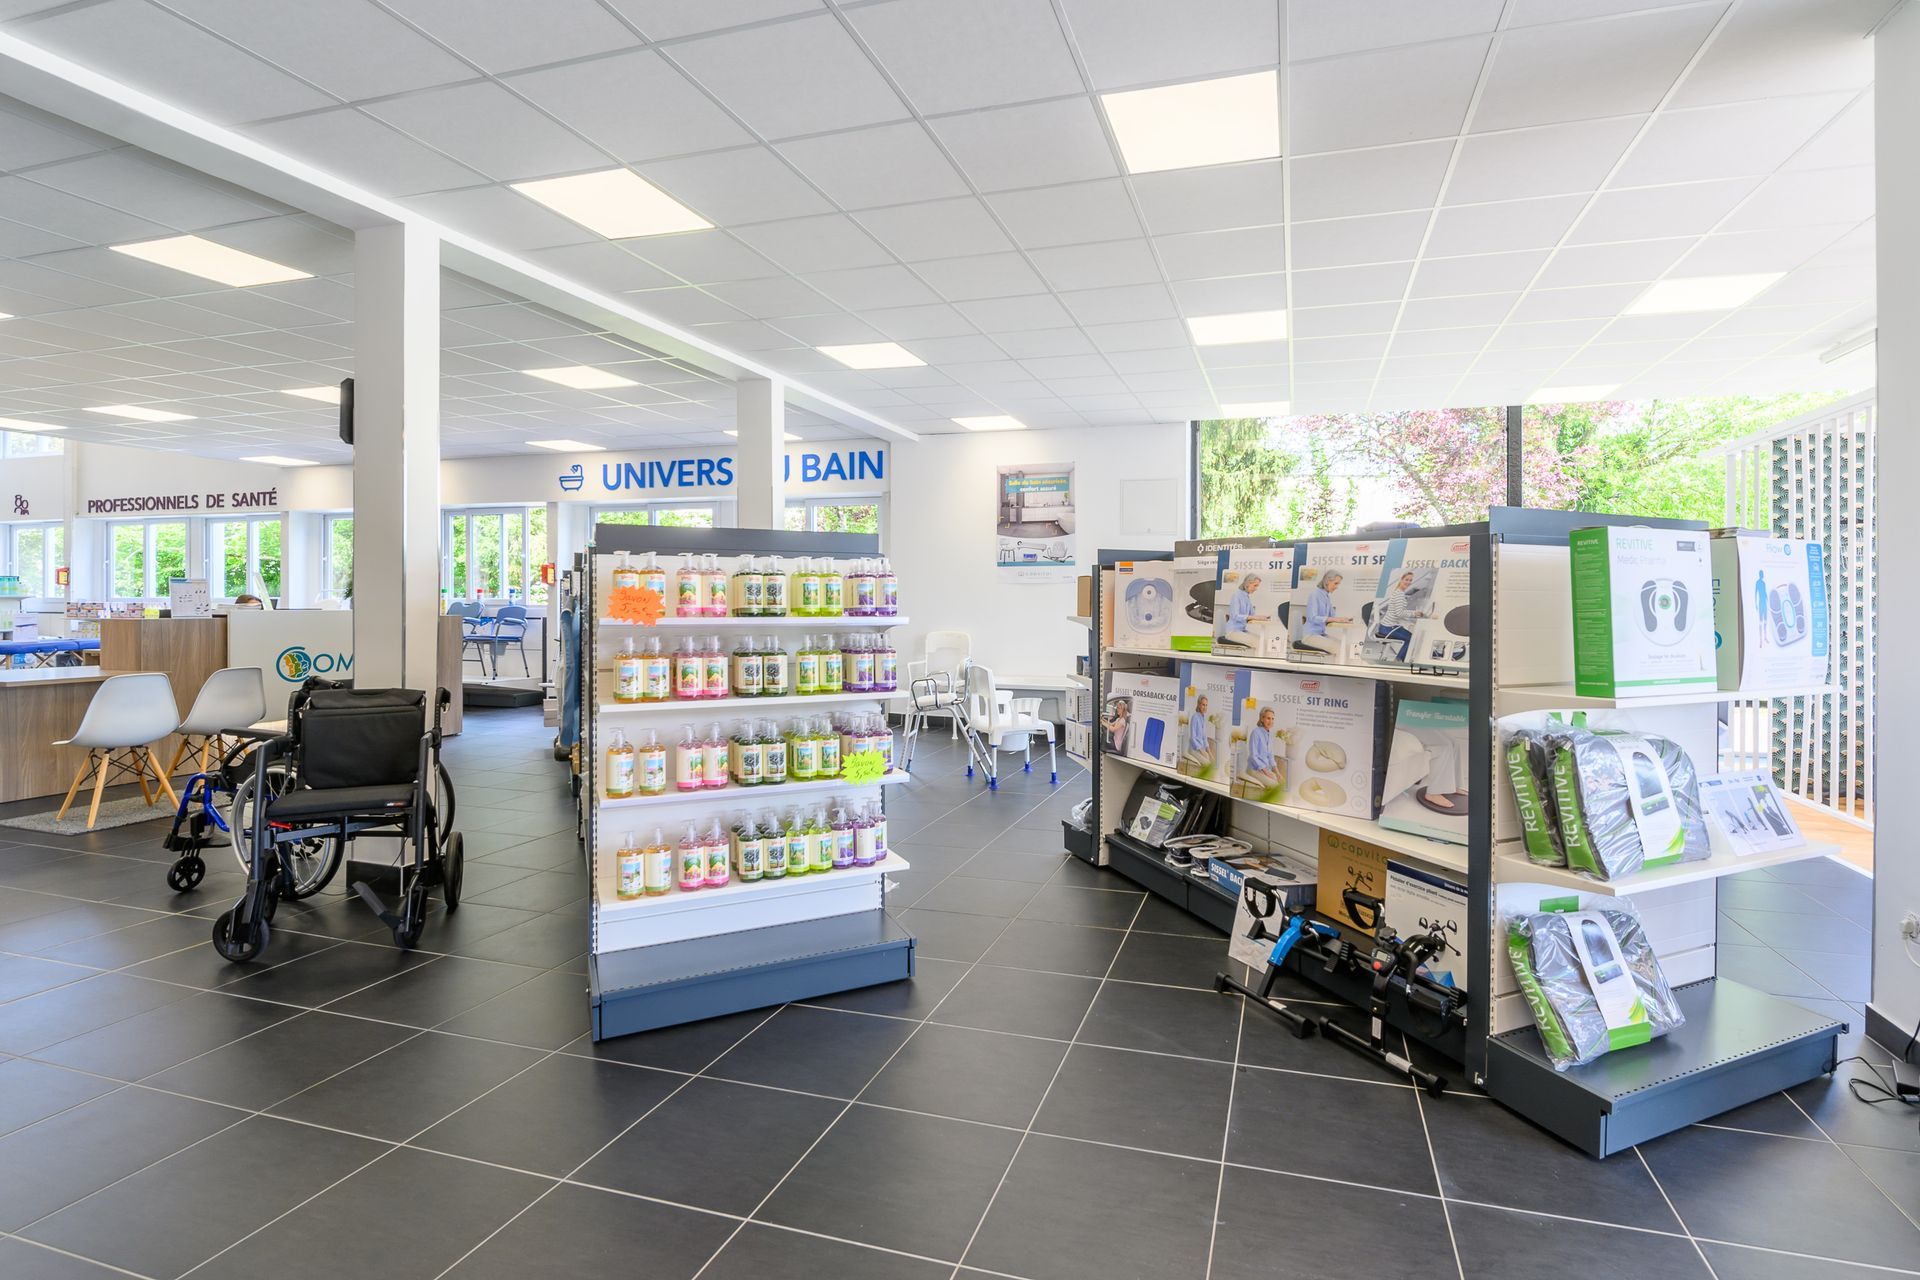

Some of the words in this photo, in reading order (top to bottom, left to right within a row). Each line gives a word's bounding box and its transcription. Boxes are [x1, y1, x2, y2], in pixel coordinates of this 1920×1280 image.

[602, 457, 734, 491] UNIVERS
[801, 450, 884, 483] BAIN
[88, 494, 199, 513] PROFESSIONNELS
[206, 493, 225, 508] DE
[231, 487, 278, 507] SANTÉ
[1616, 537, 1653, 550] REVITIVE
[1234, 561, 1263, 570] SISSEL
[1268, 560, 1284, 570] SIT
[1312, 555, 1345, 566] SISSEL
[1351, 555, 1369, 566] SIT
[1405, 559, 1438, 569] SISSEL
[1440, 558, 1469, 568] BACK
[1115, 687, 1132, 696] SISSEL
[1132, 689, 1177, 702] DORSABACK-CAR
[1207, 683, 1228, 693] SISSEL
[1273, 693, 1302, 704] SISSEL
[1306, 696, 1321, 706] SIT
[1324, 698, 1349, 708] RING
[1508, 752, 1539, 832] REVITIVE
[1554, 765, 1581, 847] REVITIVE
[1211, 863, 1228, 878] SISSEL
[1508, 946, 1551, 1030] REVITIVE
